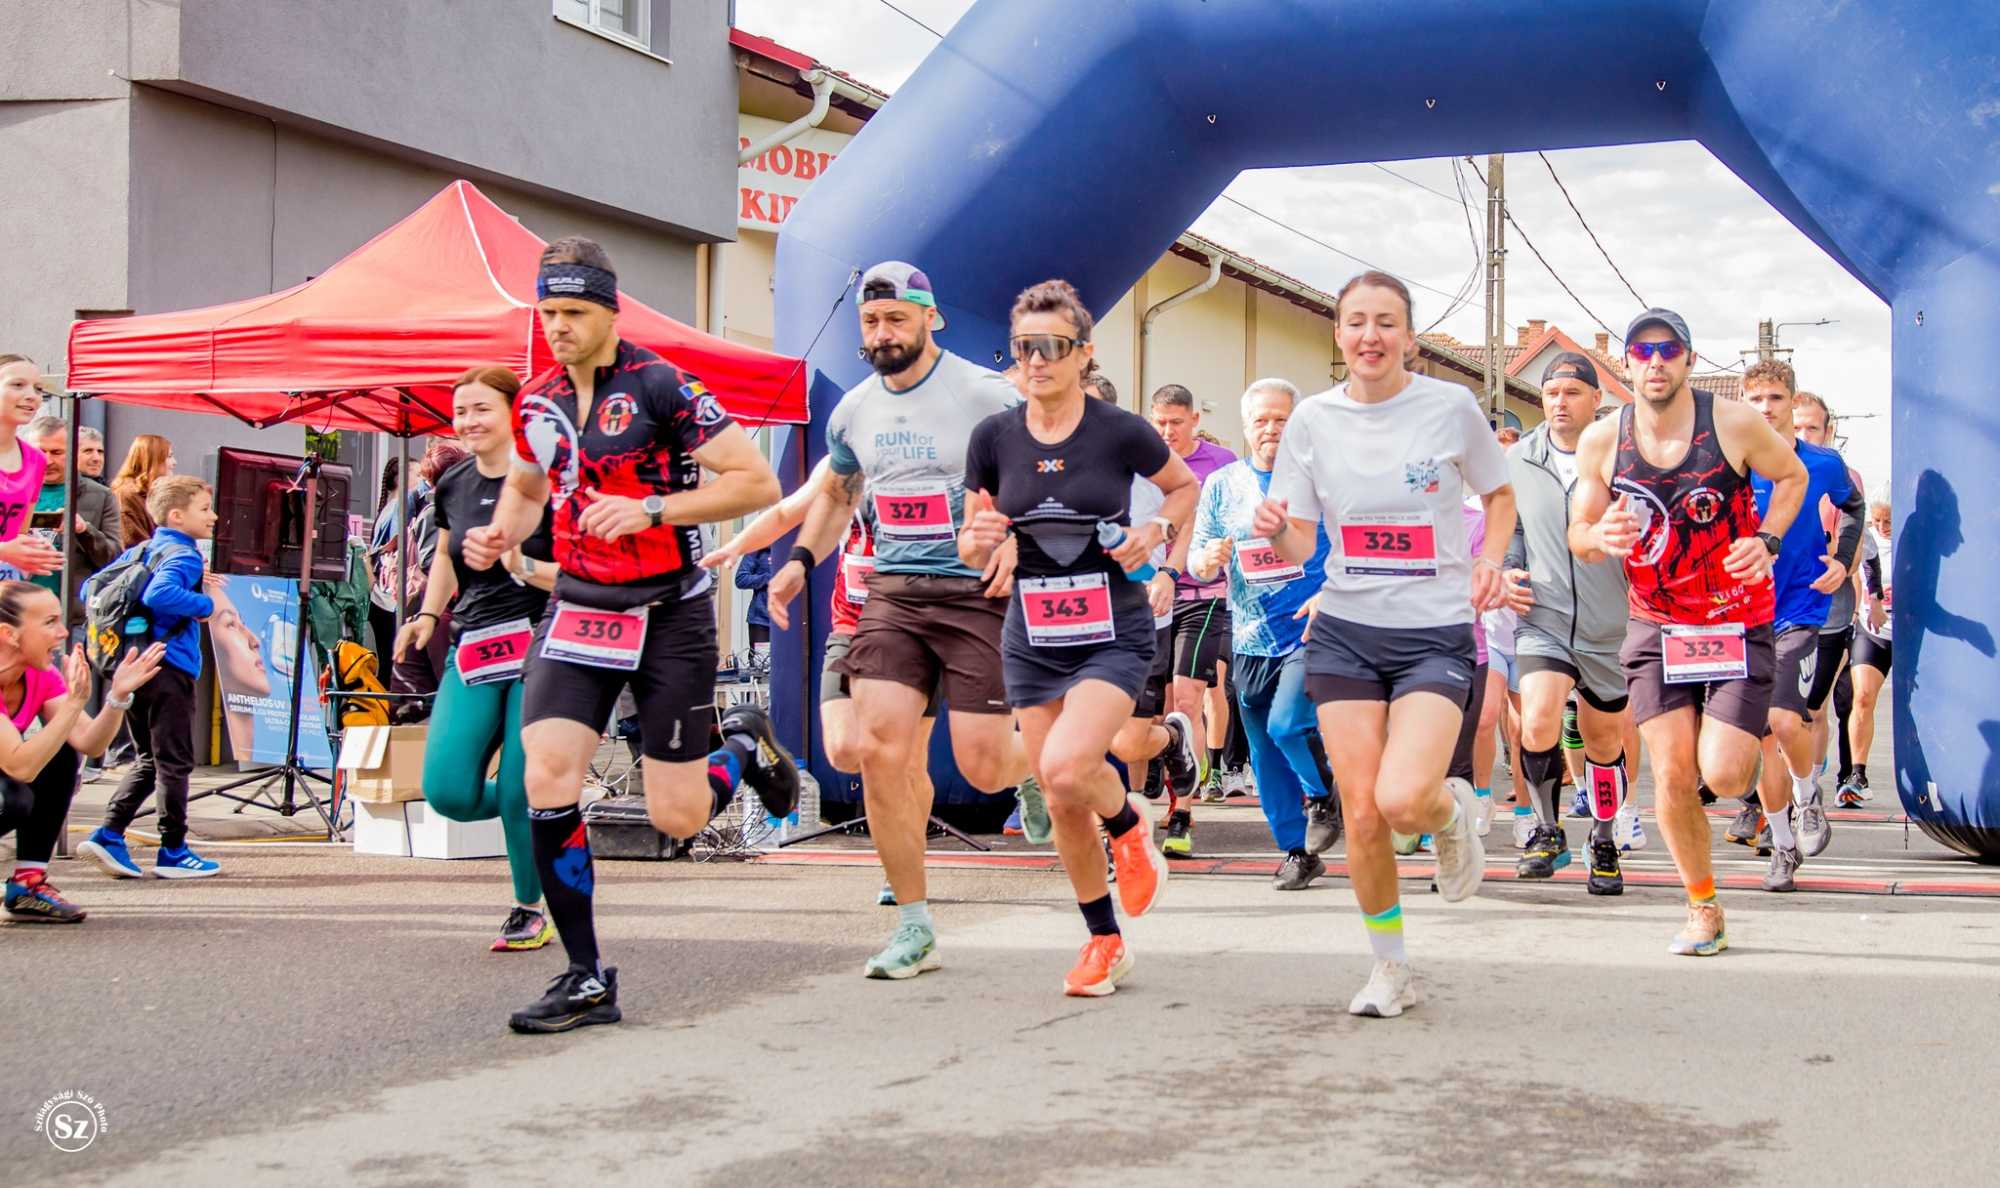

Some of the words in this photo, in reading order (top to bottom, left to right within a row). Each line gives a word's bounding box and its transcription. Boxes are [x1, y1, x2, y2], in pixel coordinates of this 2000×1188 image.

[875, 431, 912, 449] RUN
[912, 432, 935, 446] for
[902, 446, 937, 460] LIFE
[889, 502, 928, 519] 327
[1364, 531, 1412, 552] 325
[1041, 597, 1089, 618] 343
[575, 619, 623, 640] 330
[475, 639, 515, 661] 321
[1684, 640, 1725, 657] 332
[1598, 780, 1613, 808] 333
